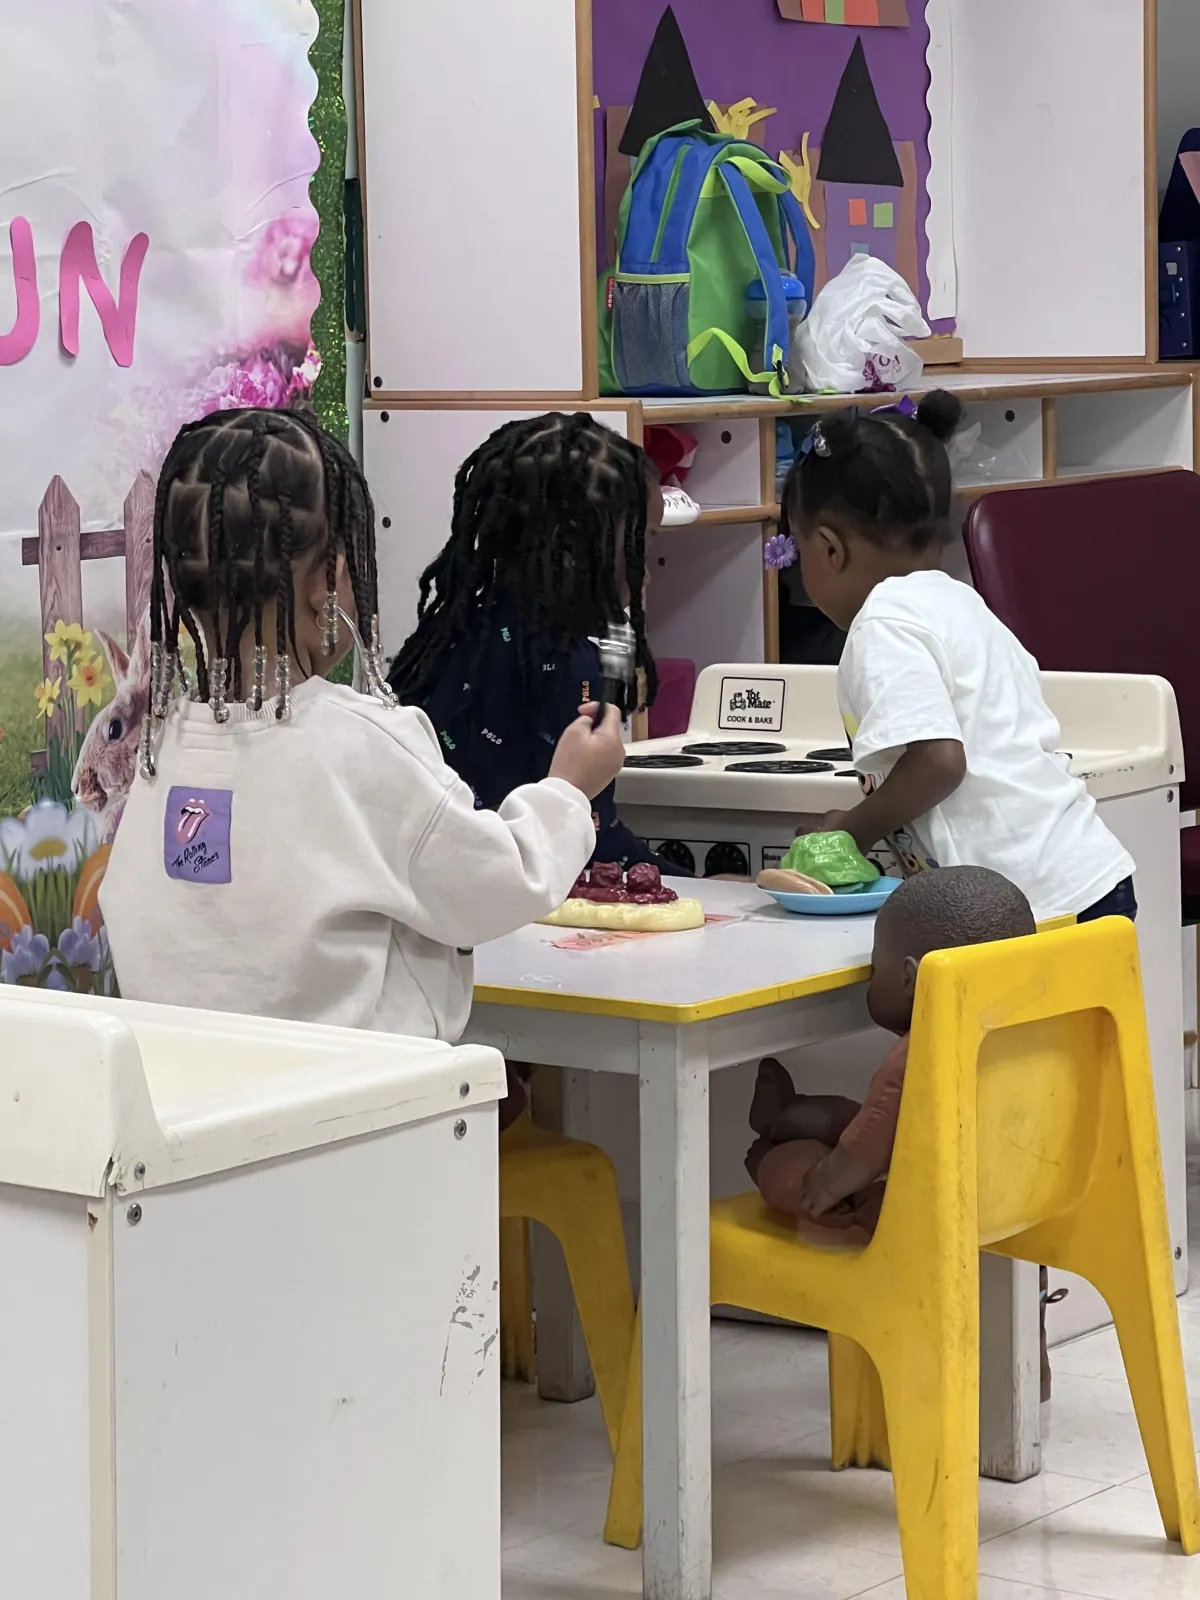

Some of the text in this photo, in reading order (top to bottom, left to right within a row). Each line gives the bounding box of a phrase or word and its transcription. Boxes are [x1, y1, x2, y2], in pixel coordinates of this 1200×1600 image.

[582, 680, 590, 702] POLO
[745, 688, 761, 701] Tot
[747, 699, 772, 709] Mate
[726, 715, 747, 723] COOK
[754, 716, 773, 724] BAKE
[440, 730, 456, 750] POLO
[480, 728, 503, 745] POLO
[172, 841, 207, 869] The Rolling
[193, 852, 220, 873] Stones
